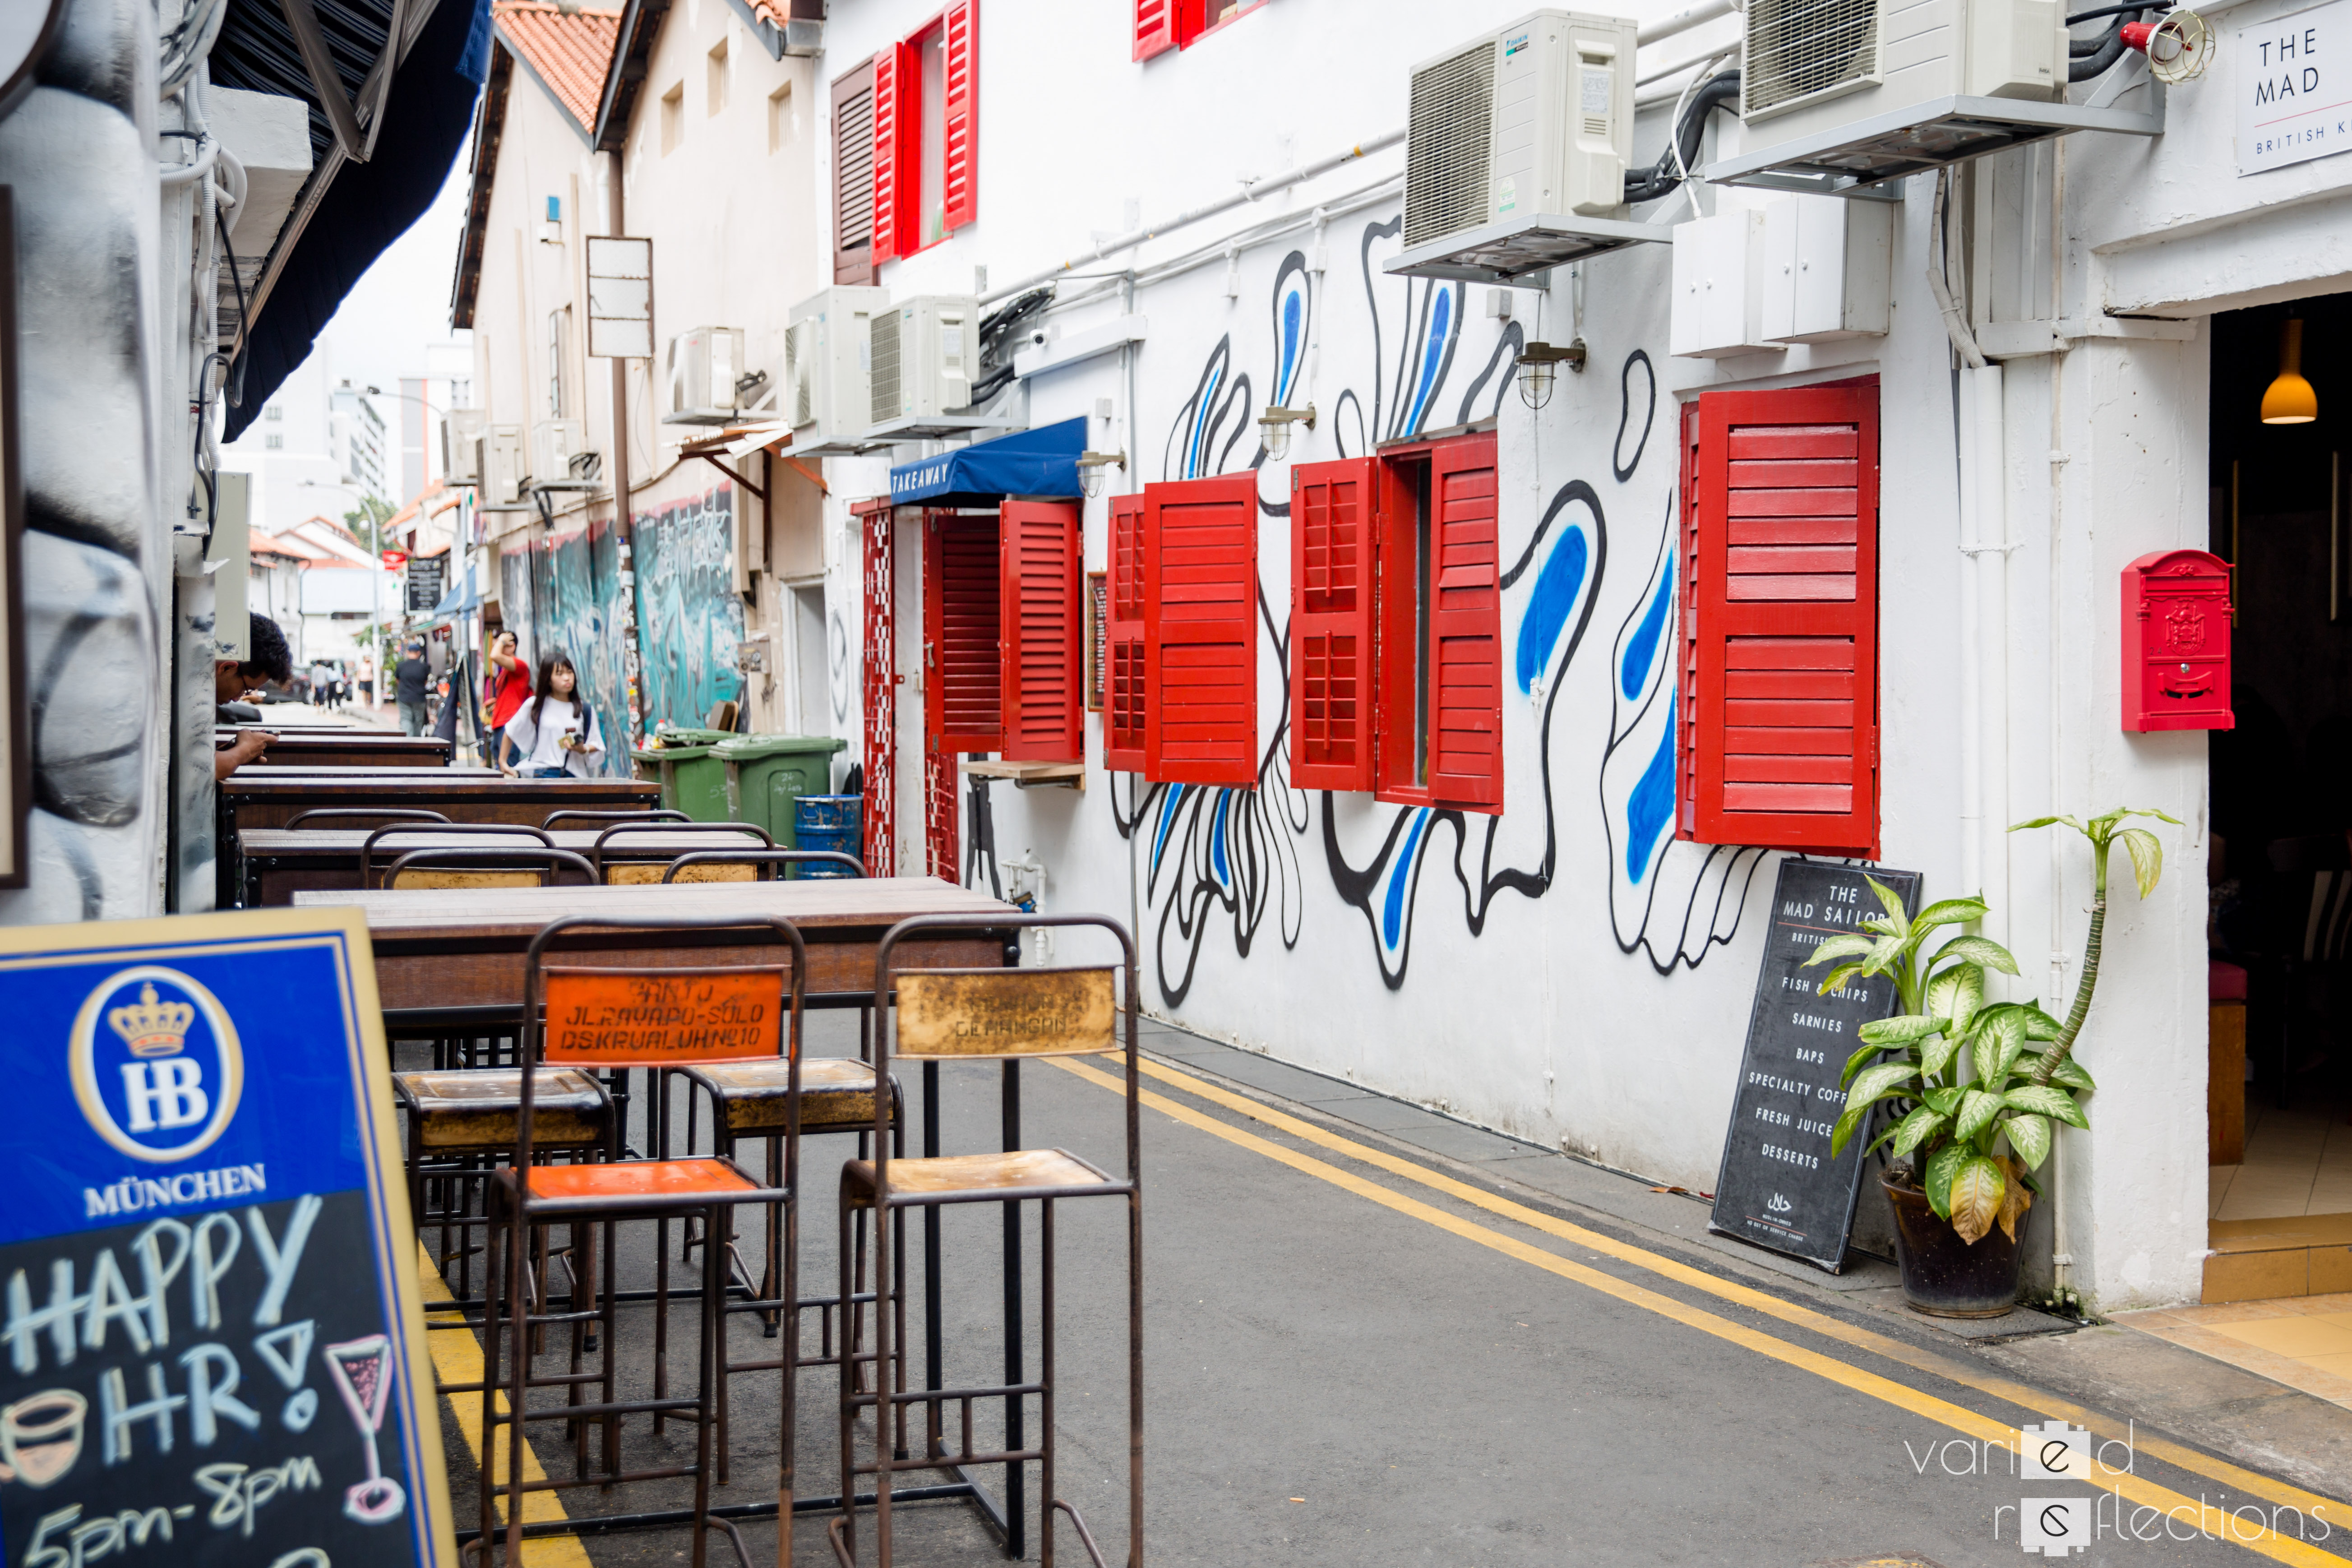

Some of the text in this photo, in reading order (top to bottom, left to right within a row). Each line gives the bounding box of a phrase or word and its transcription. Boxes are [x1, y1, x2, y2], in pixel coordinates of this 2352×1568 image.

[2260, 28, 2316, 67] THE
[2256, 67, 2319, 106] MAD
[2257, 126, 2324, 154] BRITISH
[892, 463, 948, 494] TAKEAWAY
[1830, 885, 1858, 904] THE
[1783, 901, 1814, 919] MAD
[1792, 932, 1828, 946] BRITIS
[1782, 976, 1810, 992] FISH
[1830, 987, 1868, 1002] CHIPS
[1792, 1012, 1842, 1033] SARNIES
[1796, 1047, 1824, 1064] BAPS
[120, 1056, 210, 1134] HB
[1748, 1071, 1848, 1104] SPECIALTY COFF
[1755, 1107, 1833, 1138] FRESH JUICE
[1761, 1143, 1819, 1170] DESSERTS
[84, 1162, 267, 1219] MÜNCHEN
[1767, 1192, 1792, 1212] حلال
[1770, 1227, 1787, 1237] SERVICE
[1788, 1232, 1804, 1242] CHARGE
[0, 1193, 323, 1376] HAPPY
